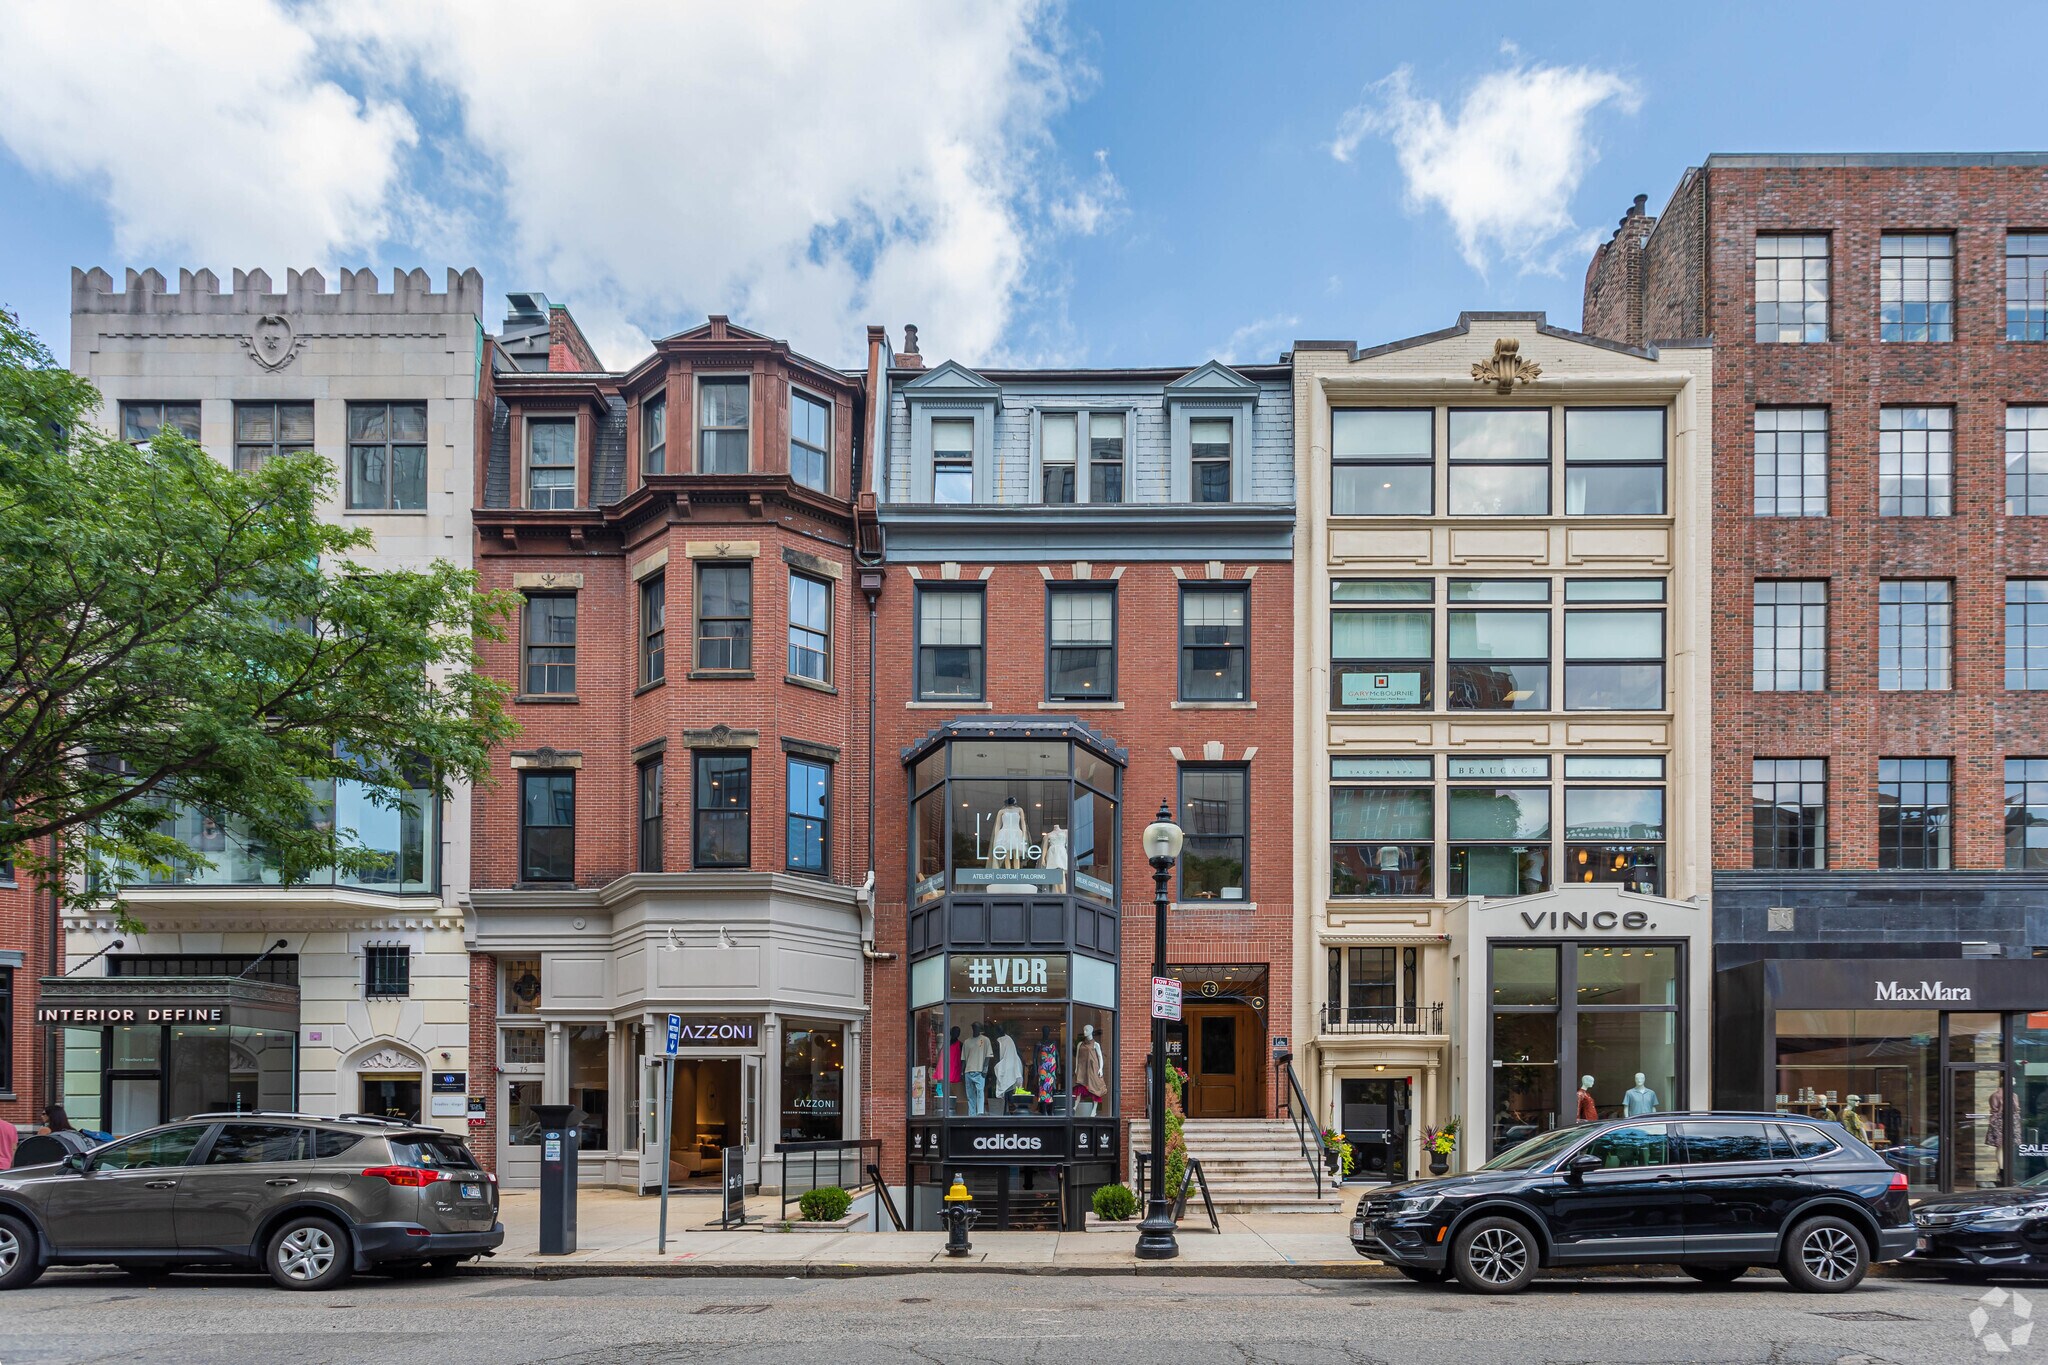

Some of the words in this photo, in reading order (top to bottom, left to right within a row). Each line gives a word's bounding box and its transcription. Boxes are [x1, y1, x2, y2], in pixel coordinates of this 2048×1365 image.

[969, 958, 1047, 984] #VDR
[38, 1009, 135, 1021] INTERIOR
[148, 1009, 221, 1021] DEFINE
[681, 1025, 752, 1038] AZZONI
[973, 1134, 1042, 1149] adidas
[2019, 1144, 2048, 1152] SALE
